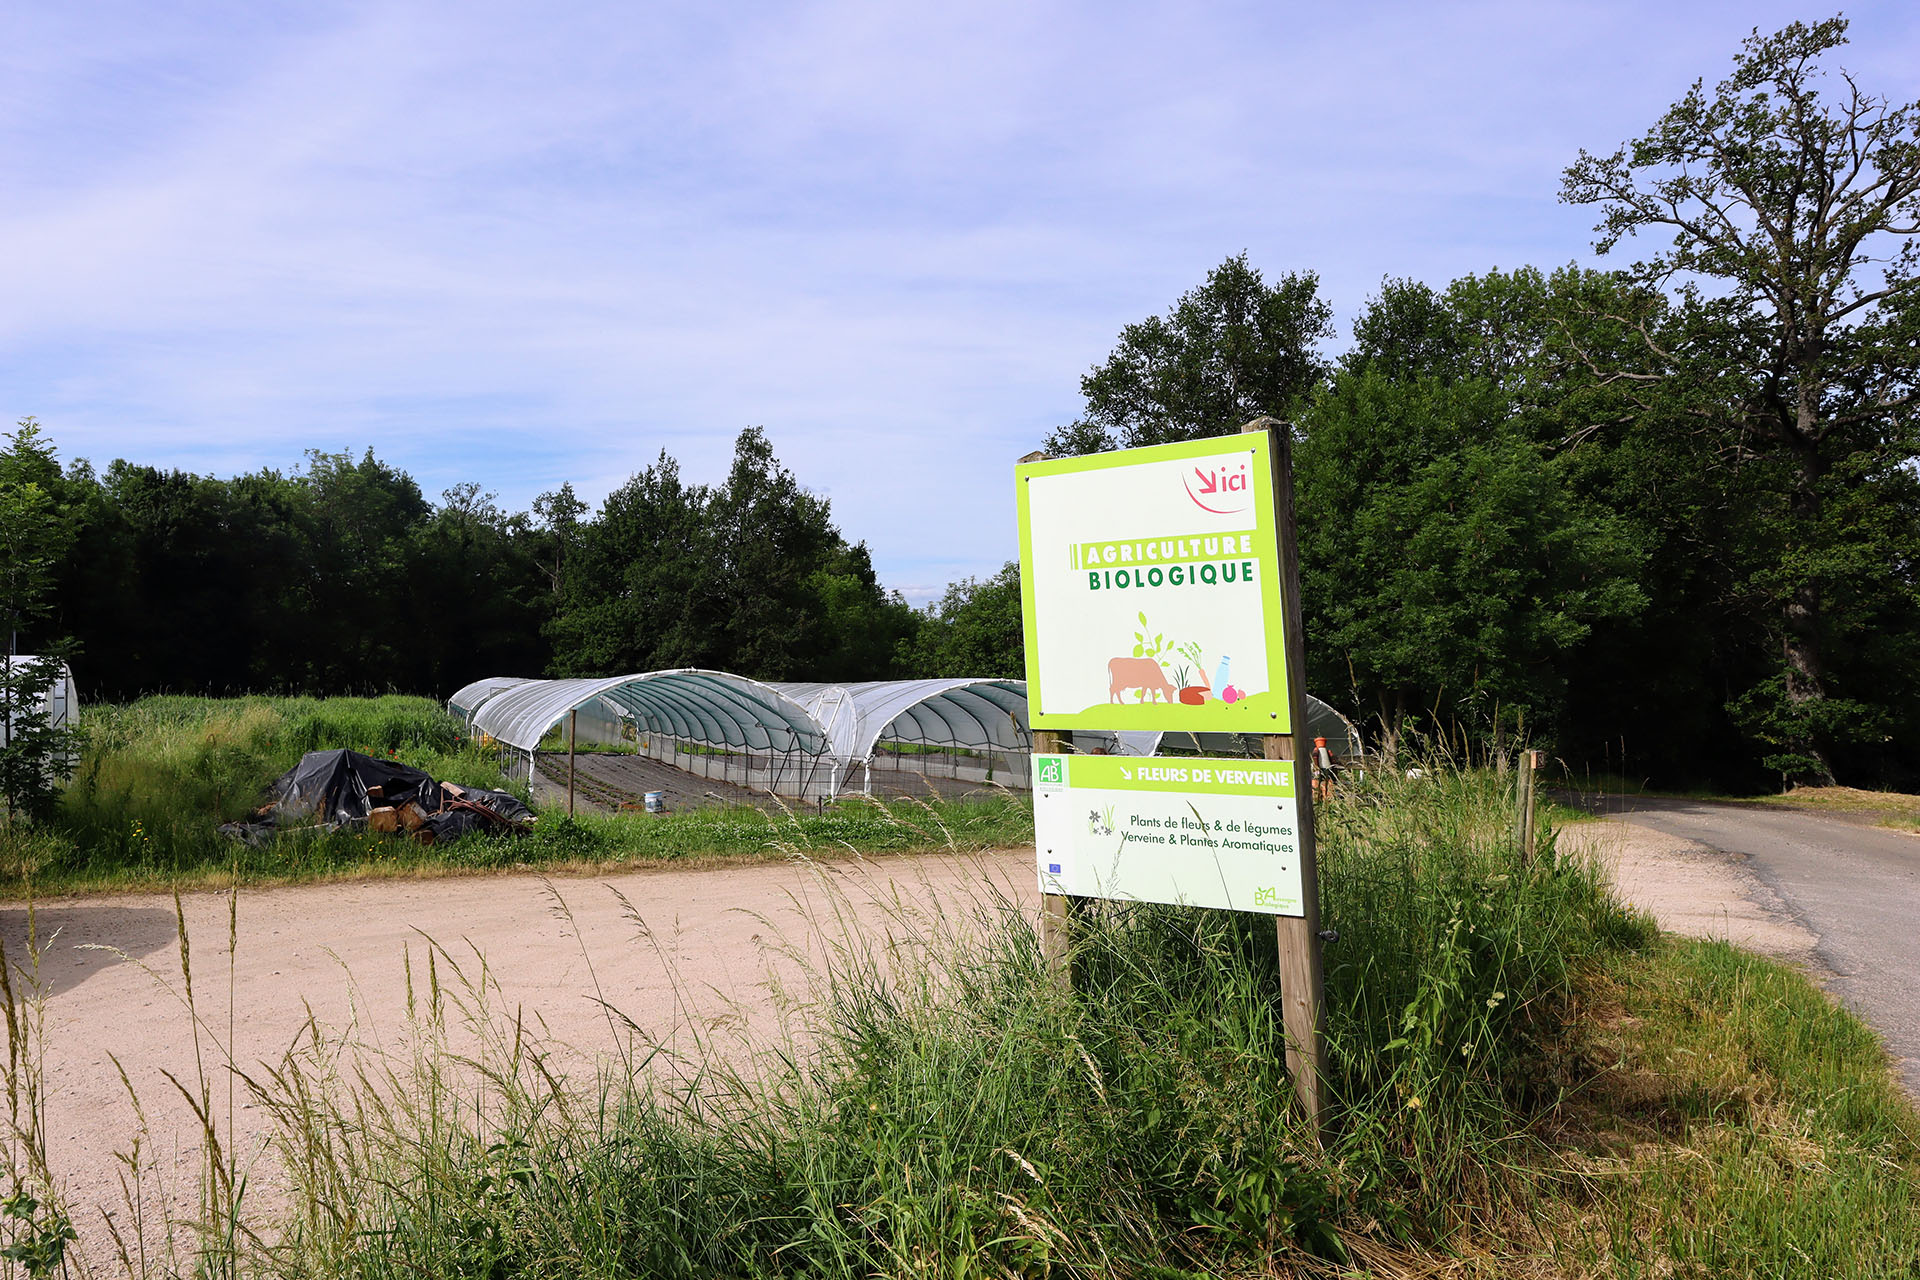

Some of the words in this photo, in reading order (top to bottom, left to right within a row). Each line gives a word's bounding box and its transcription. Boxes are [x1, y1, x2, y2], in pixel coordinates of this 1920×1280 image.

[1221, 464, 1246, 493] ici
[1087, 534, 1252, 565] AGRICULTURE
[1089, 561, 1253, 590] BIOLOGIQUE
[1040, 765, 1059, 782] AB
[1137, 767, 1188, 783] FLEURS
[1193, 769, 1212, 783] DE
[1215, 770, 1289, 786] VERVEINE
[1130, 815, 1161, 829] Plants
[1164, 816, 1179, 829] de
[1214, 819, 1223, 832] &
[1226, 819, 1241, 833] de
[1244, 820, 1292, 837] légumes
[1121, 831, 1165, 844] Verveine
[1168, 834, 1177, 845] &
[1180, 834, 1219, 848] Plantes
[1222, 837, 1294, 855] Aromatiques
